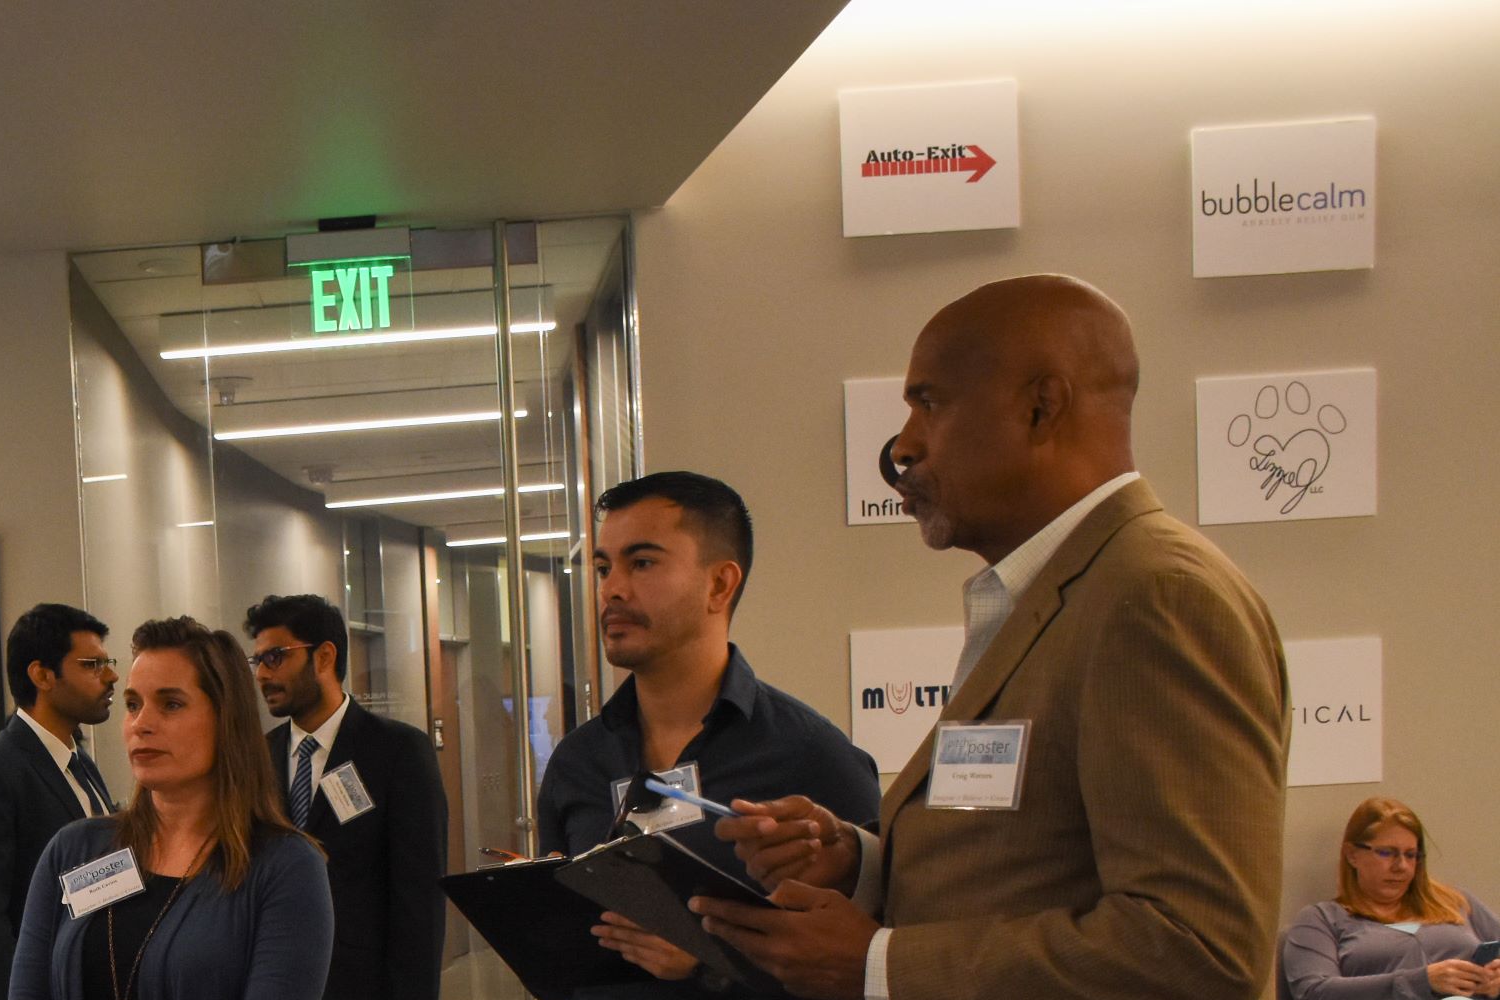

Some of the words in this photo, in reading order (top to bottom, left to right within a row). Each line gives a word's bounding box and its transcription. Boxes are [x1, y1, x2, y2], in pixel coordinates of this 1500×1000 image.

[866, 144, 966, 163] Auto-Exit
[1202, 178, 1365, 216] bubblecalm
[312, 265, 393, 332] EXIT
[968, 740, 1010, 756] poster
[91, 858, 125, 879] poster
